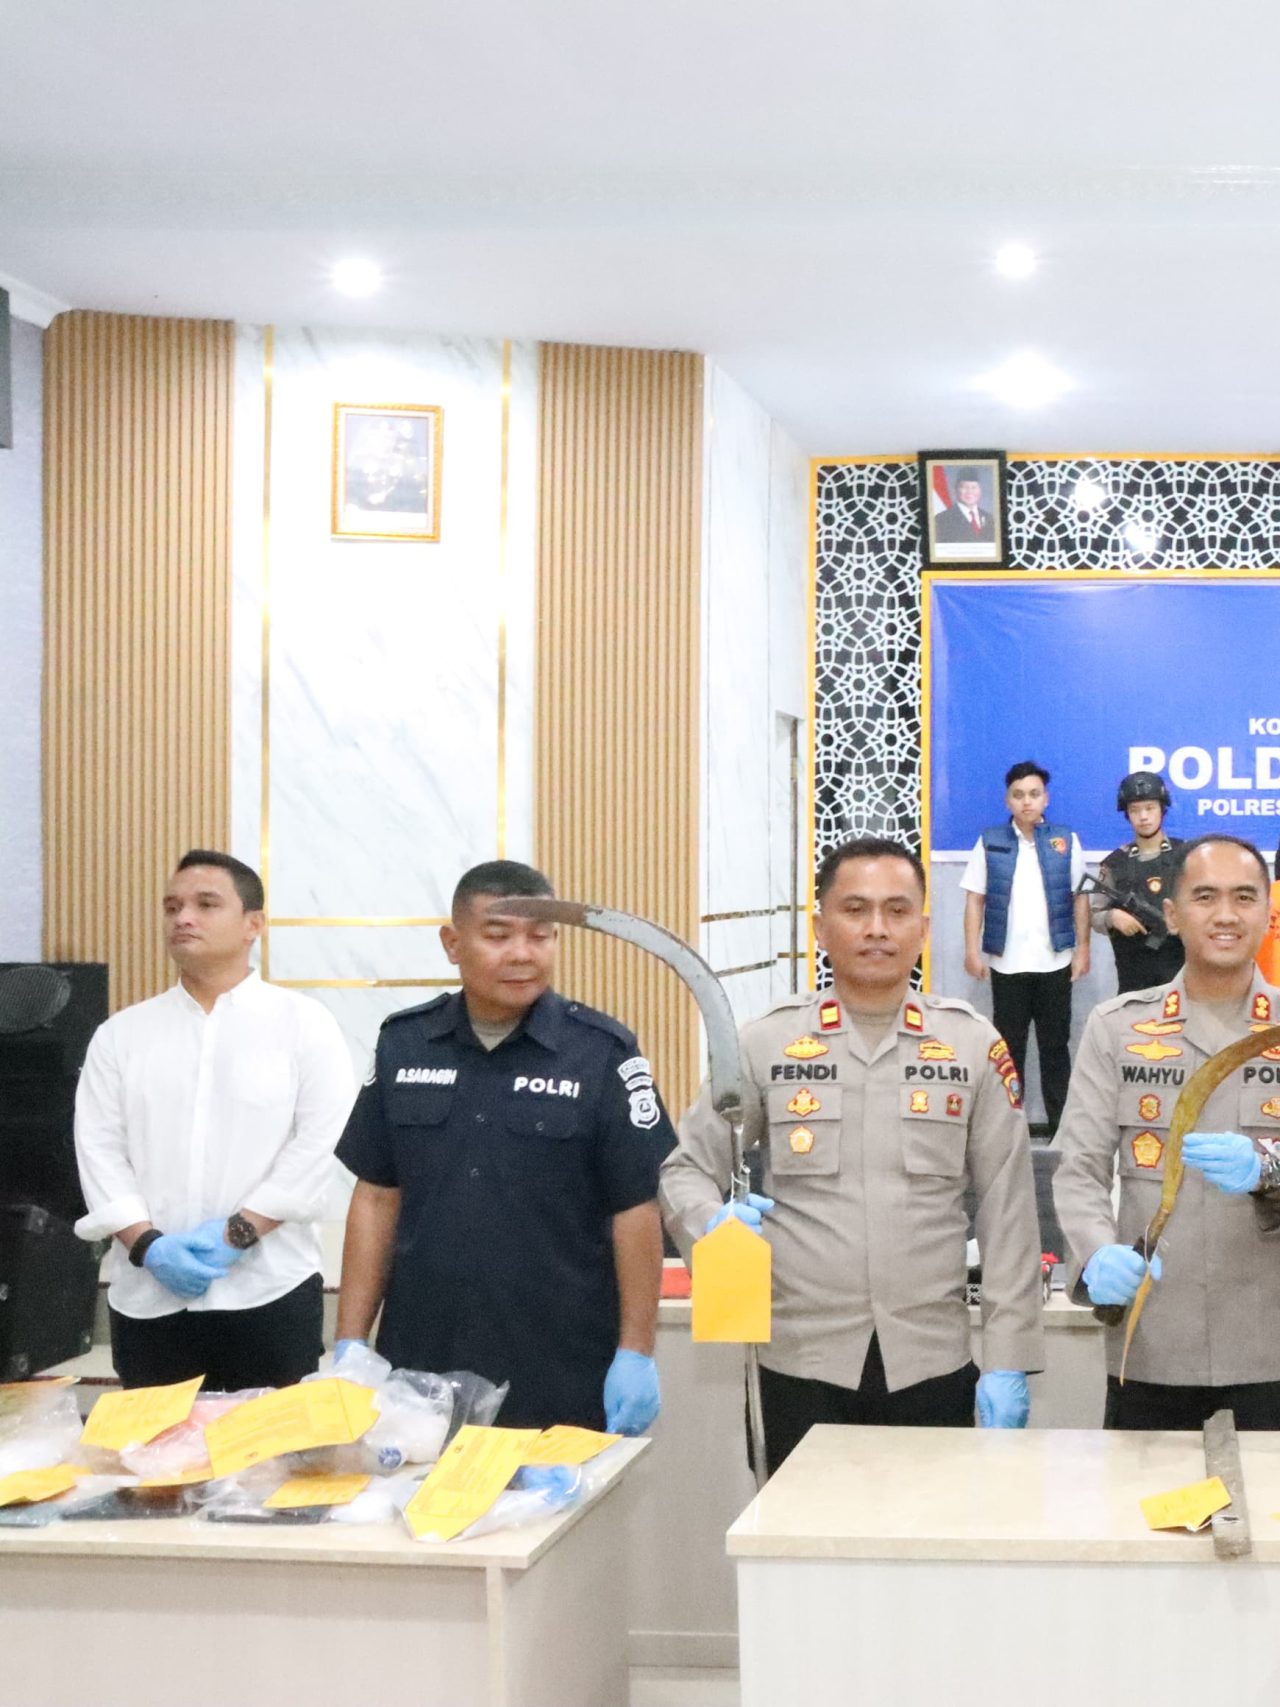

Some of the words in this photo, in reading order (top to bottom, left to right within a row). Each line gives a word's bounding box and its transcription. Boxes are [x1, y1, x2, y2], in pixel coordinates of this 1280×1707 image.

[771, 1064, 838, 1081] FENDI
[905, 1065, 969, 1082] POLRI
[1121, 1066, 1185, 1086] WAHYU
[513, 1076, 580, 1098] POLRI
